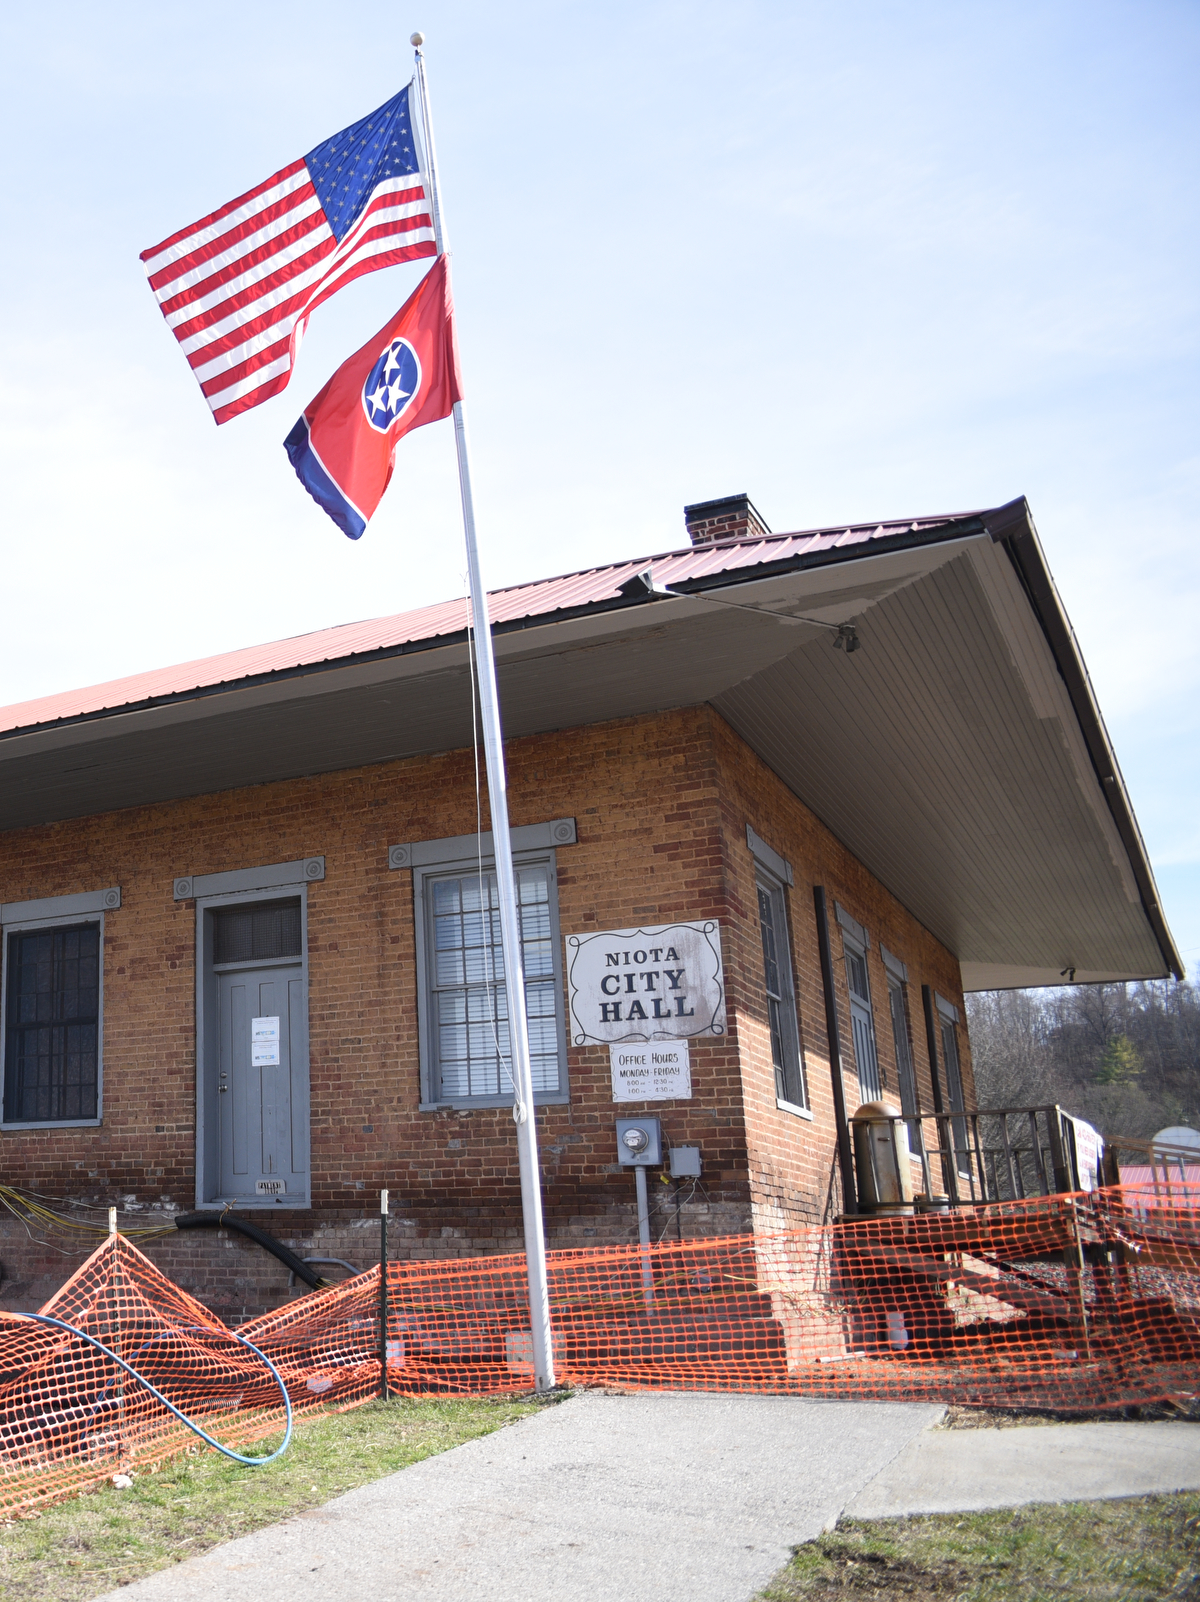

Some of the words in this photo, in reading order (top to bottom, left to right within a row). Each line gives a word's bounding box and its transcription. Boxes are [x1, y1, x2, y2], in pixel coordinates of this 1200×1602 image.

[605, 947, 680, 967] NIOTA
[601, 969, 685, 995] CITY
[599, 996, 694, 1022] HALL
[619, 1054, 646, 1066] OFFICE
[651, 1053, 678, 1064] HOURS
